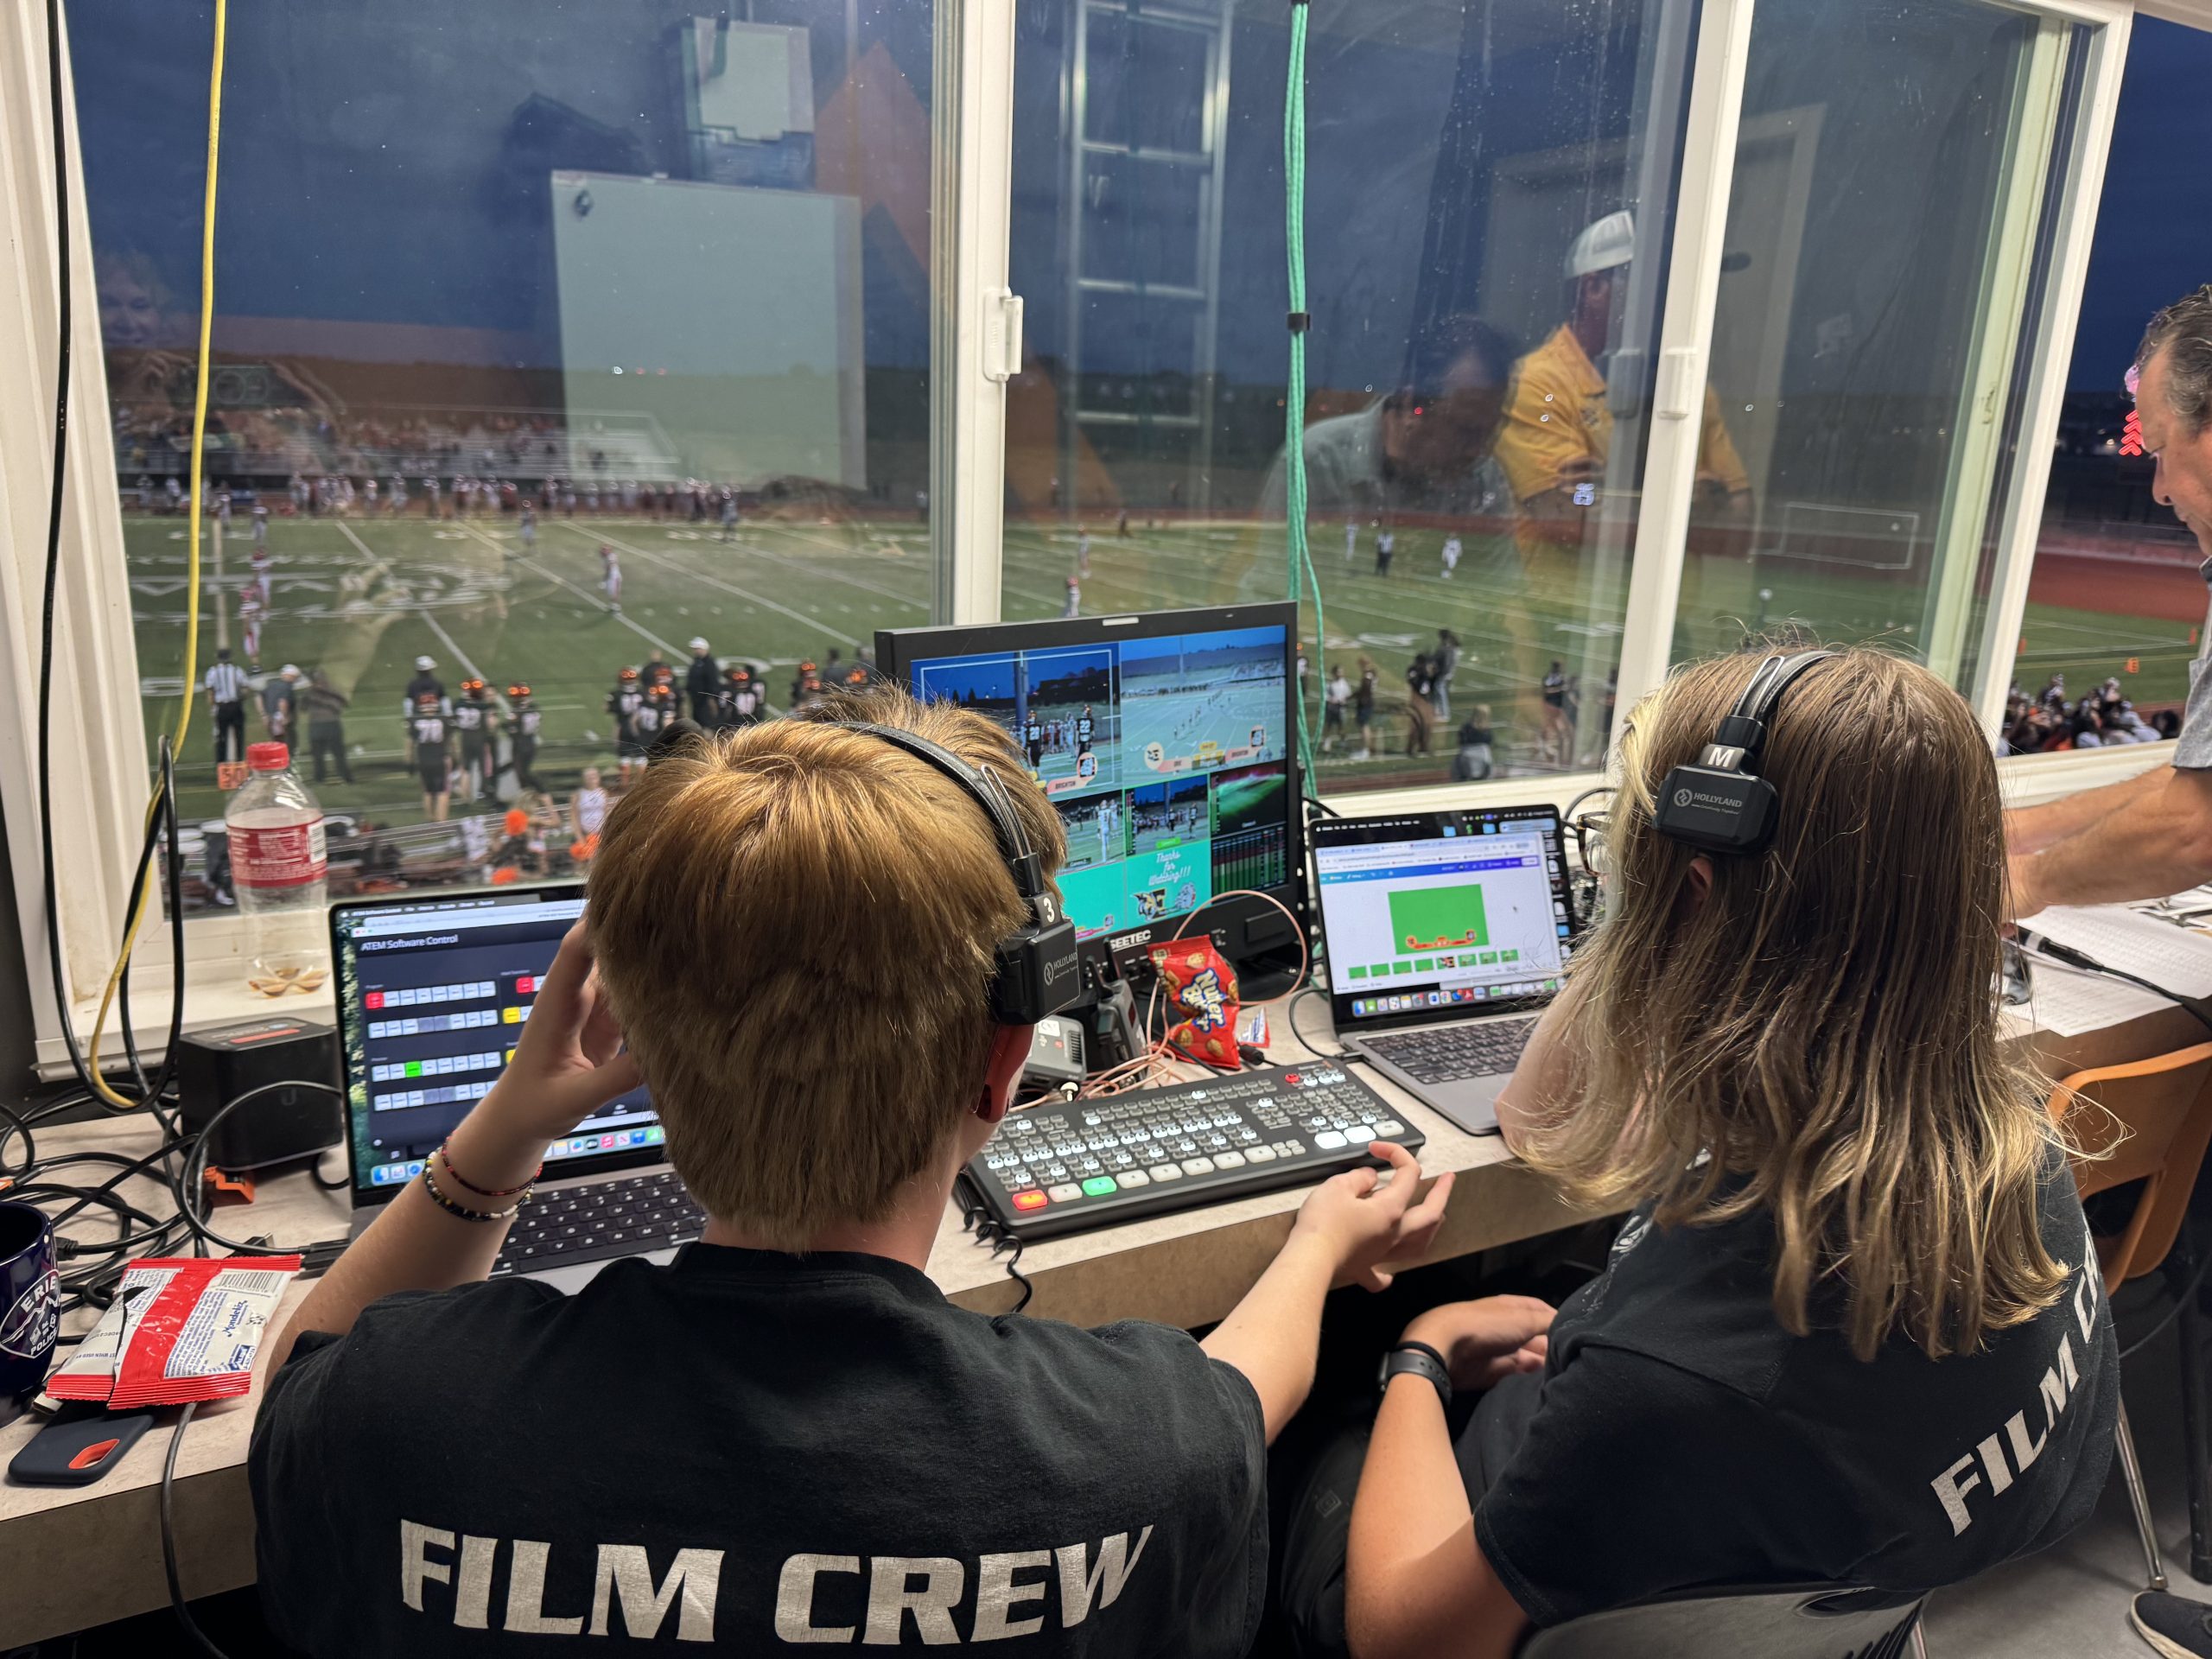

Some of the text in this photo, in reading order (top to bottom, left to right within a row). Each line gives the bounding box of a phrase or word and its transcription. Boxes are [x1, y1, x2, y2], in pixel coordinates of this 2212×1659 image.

[1707, 747, 1735, 767] M
[1693, 791, 1743, 808] HOLLYLAND
[1043, 897, 1055, 923] 3
[360, 934, 459, 951] ATEM Software Control
[1109, 929, 1152, 950] SEETEC
[1053, 952, 1077, 970] HOLLYLAND
[20, 1274, 57, 1313] ERIE
[30, 1326, 58, 1357] POLICE
[1929, 1331, 2080, 1538] FILM
[400, 1518, 1156, 1645] FILM CREW
